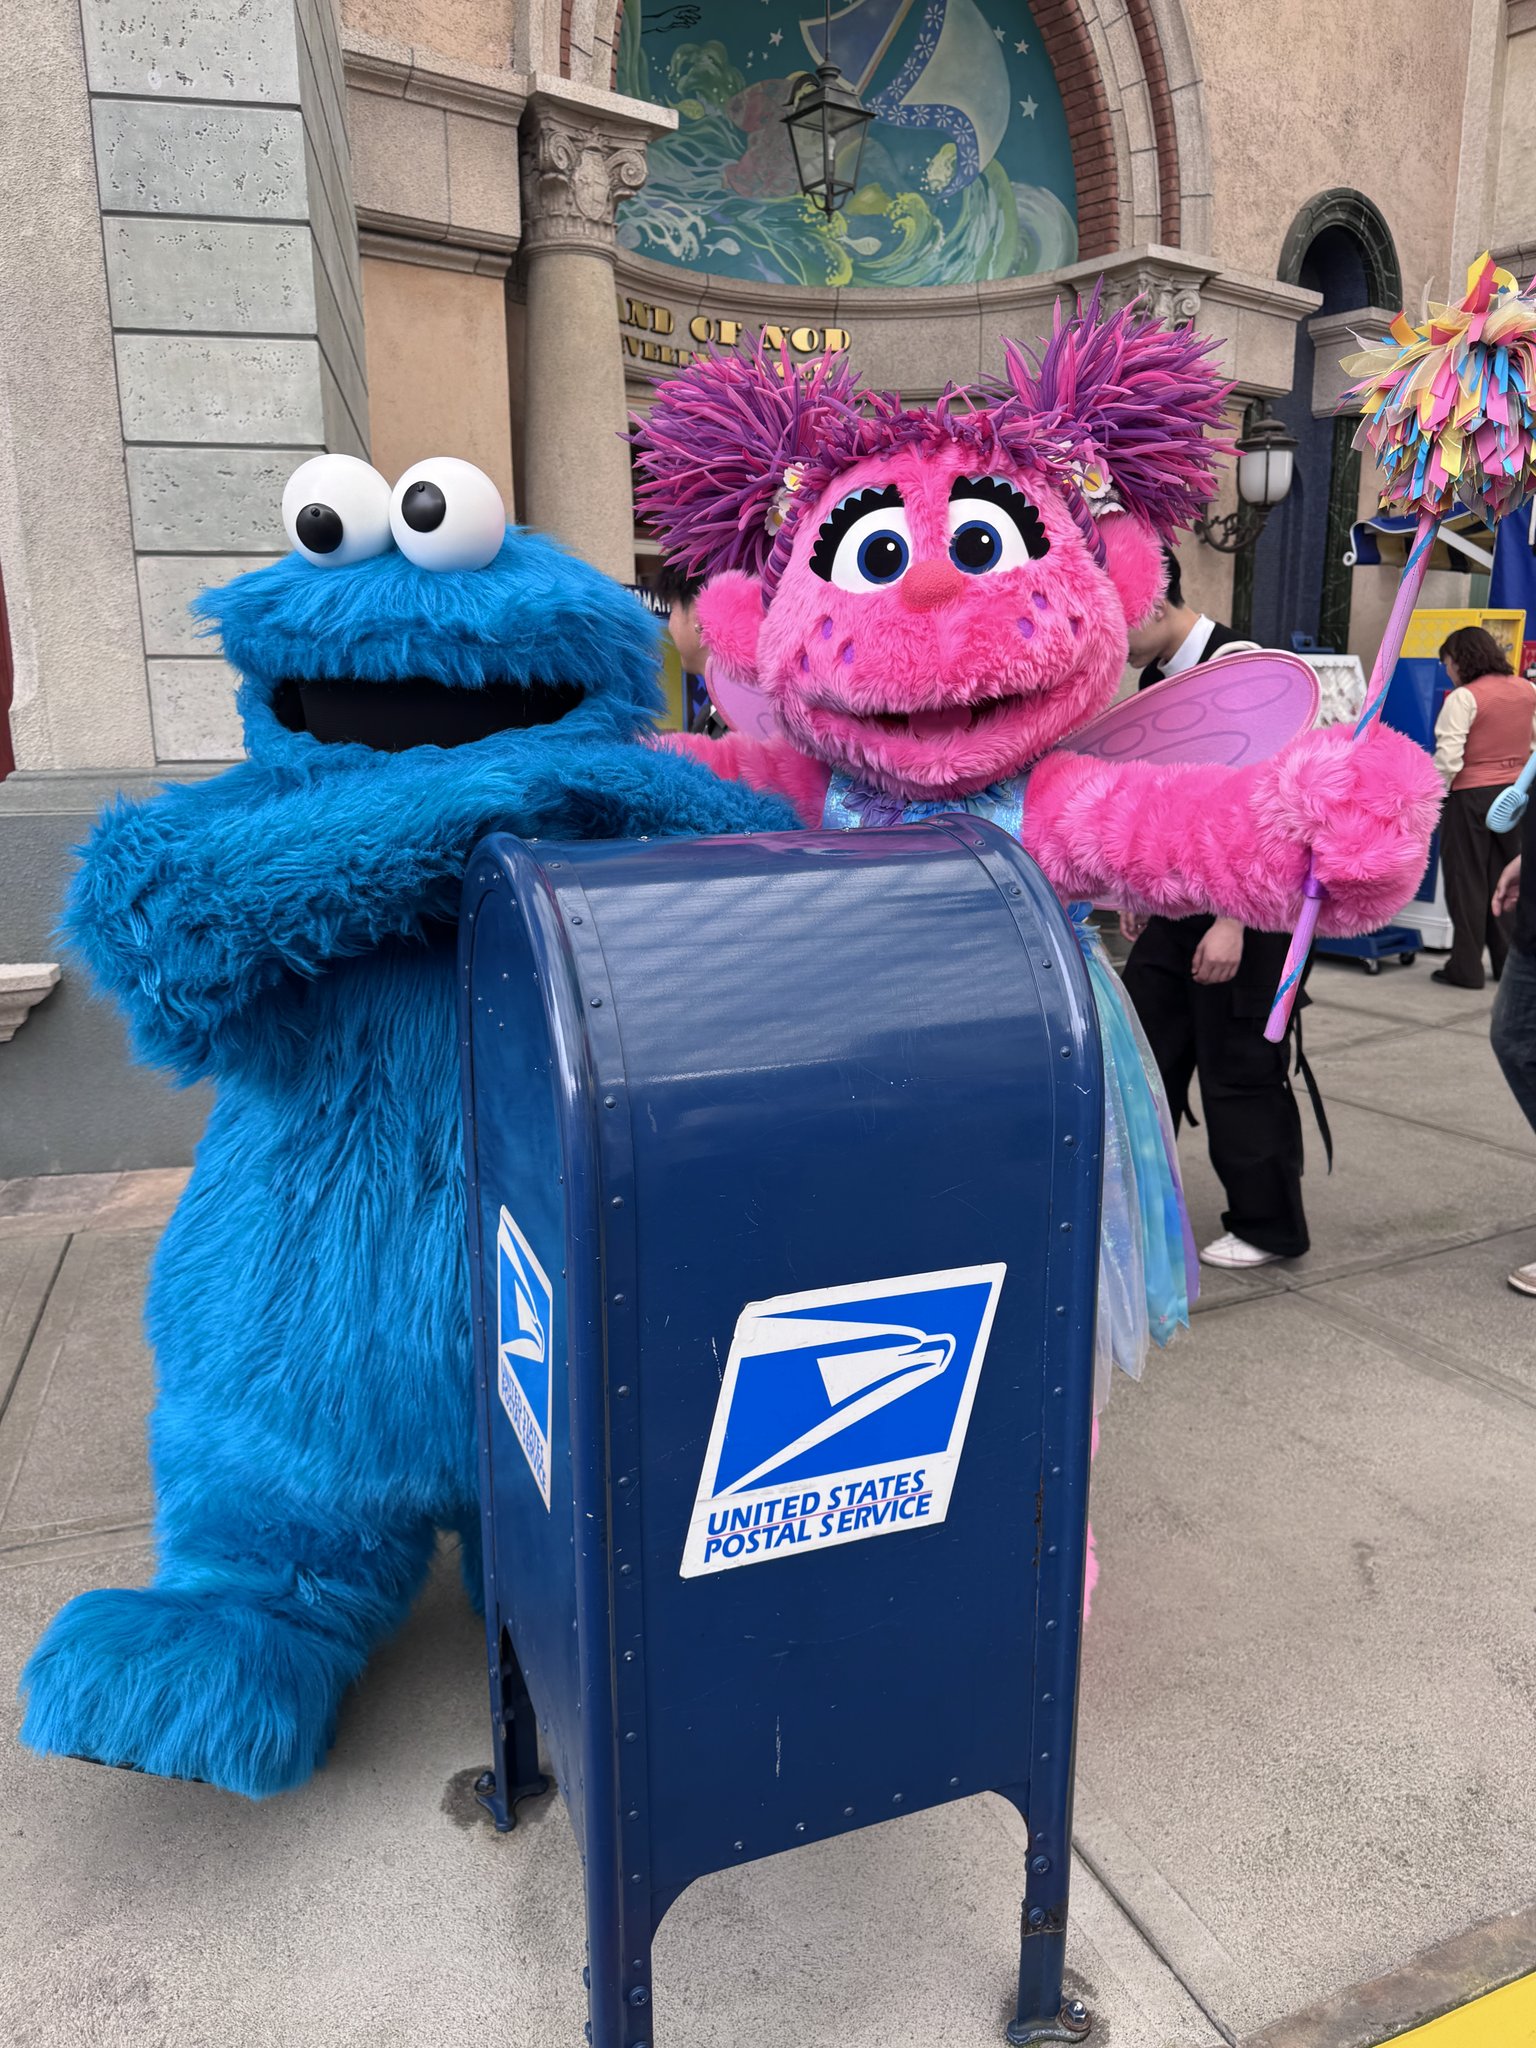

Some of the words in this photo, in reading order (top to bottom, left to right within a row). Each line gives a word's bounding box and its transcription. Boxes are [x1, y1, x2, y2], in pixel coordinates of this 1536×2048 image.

[690, 316, 743, 346] OF
[760, 325, 850, 353] NOD
[703, 1522, 812, 1563] POSTAL
[819, 1493, 932, 1537] SERVICE
[707, 1491, 820, 1536] UNITED
[827, 1469, 926, 1511] STATES
